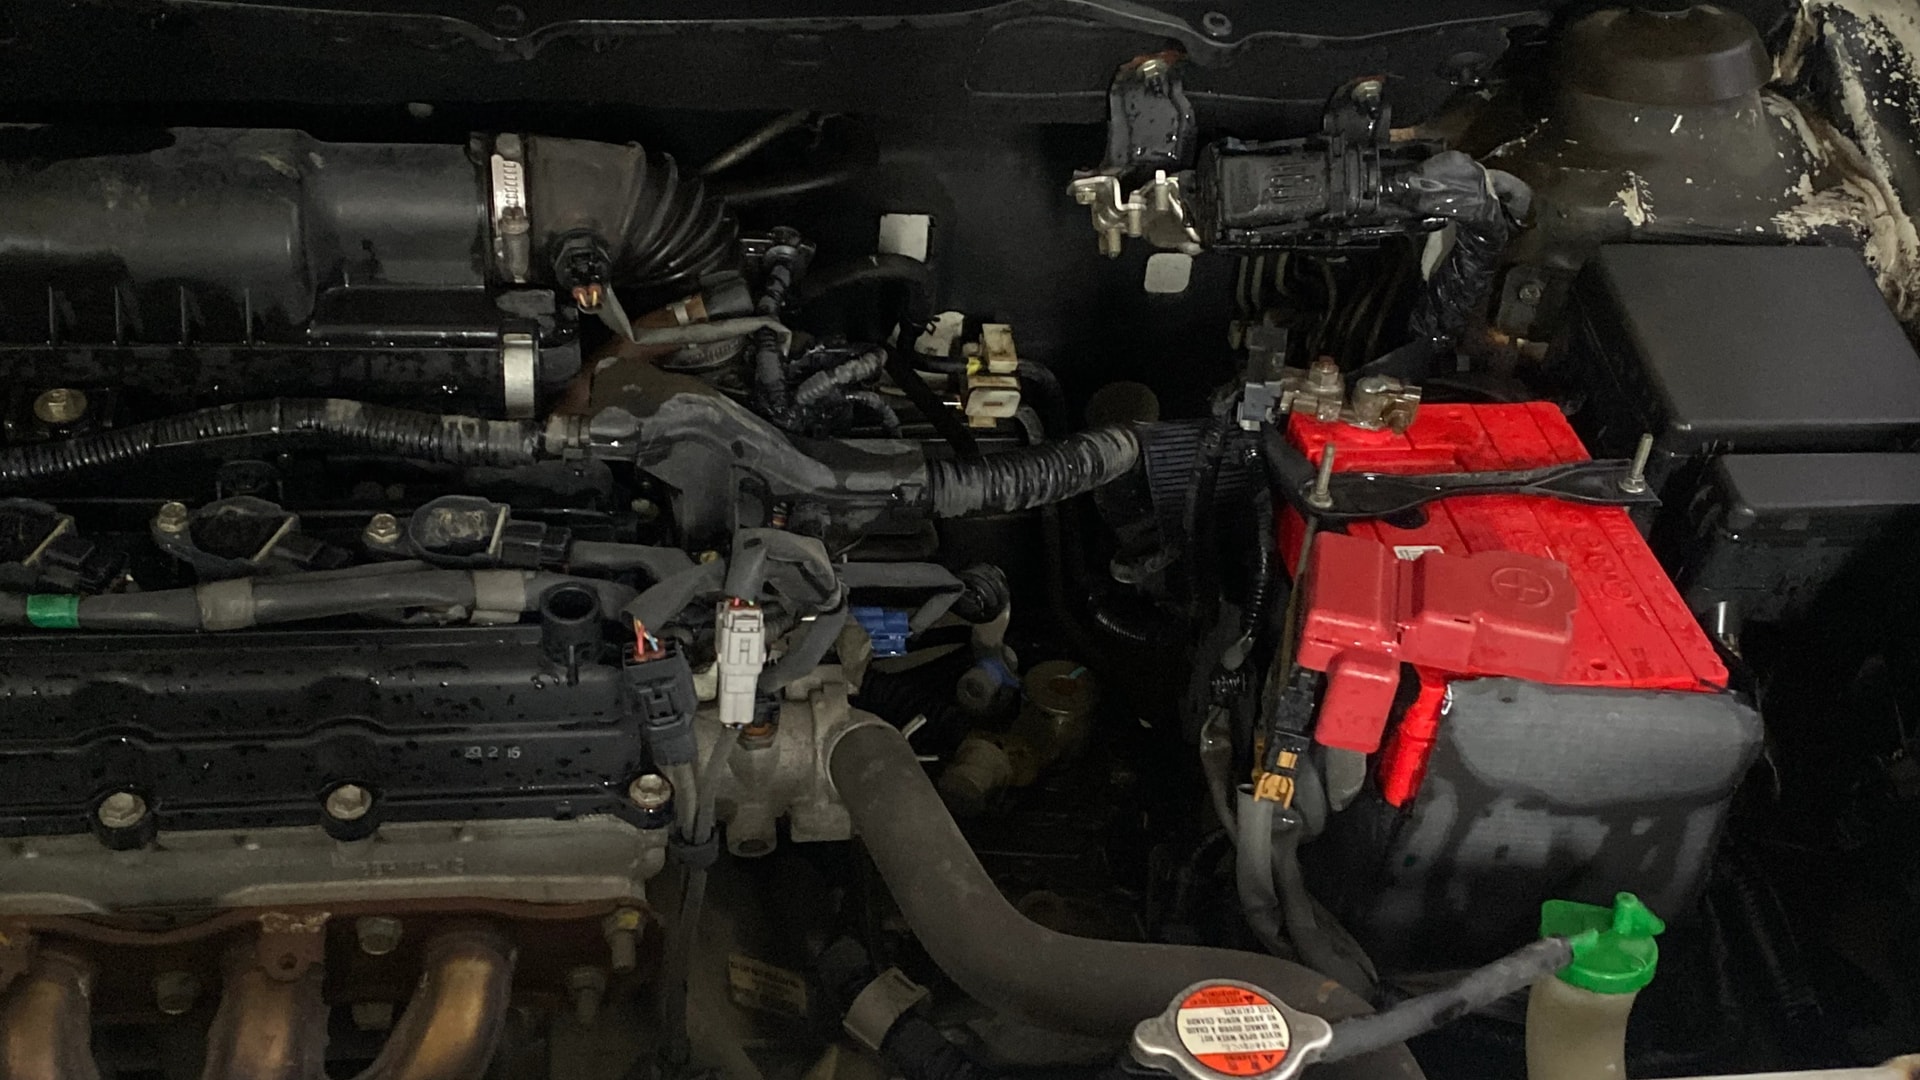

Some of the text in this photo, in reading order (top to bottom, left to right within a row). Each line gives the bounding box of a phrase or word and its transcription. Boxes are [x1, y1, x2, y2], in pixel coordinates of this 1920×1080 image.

[1244, 1024, 1268, 1032] JAMAIS
[1217, 1034, 1237, 1042] WHEN
[1239, 1033, 1257, 1041] OPEN
[1260, 1032, 1282, 1040] NEVER
